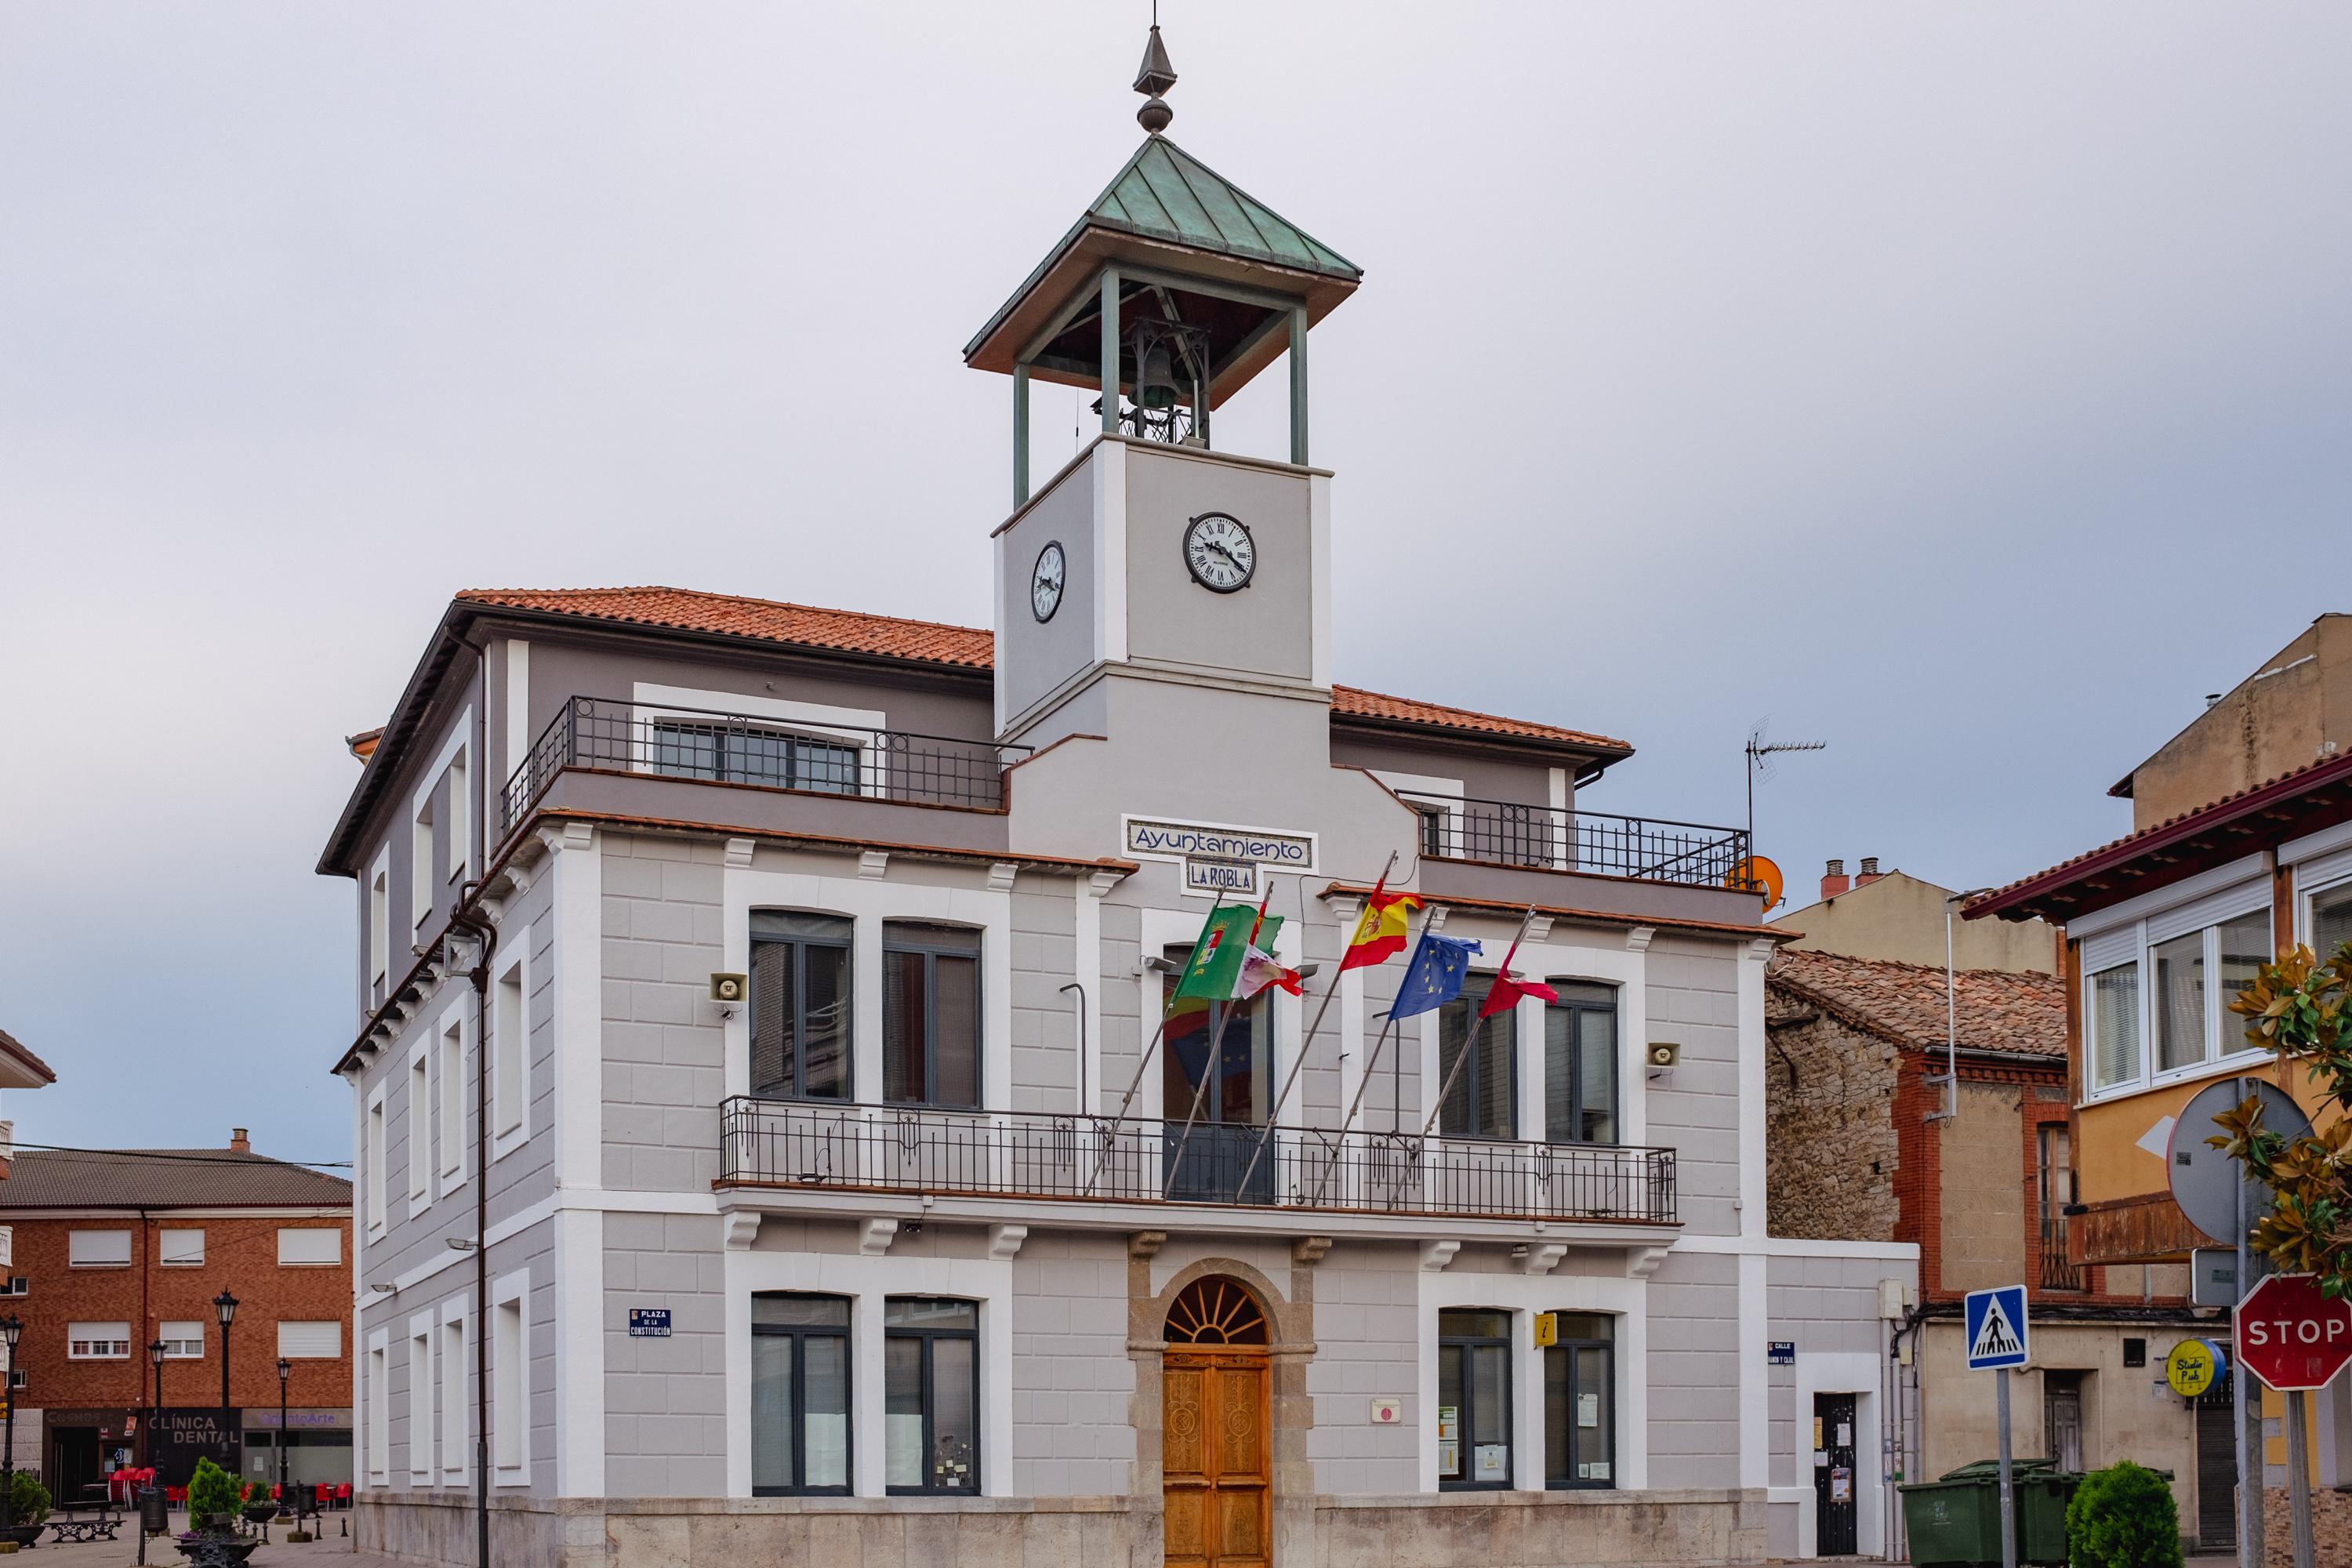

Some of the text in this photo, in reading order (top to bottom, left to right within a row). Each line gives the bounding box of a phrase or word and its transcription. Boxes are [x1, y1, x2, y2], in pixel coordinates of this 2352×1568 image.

[1135, 827, 1303, 860] Ayuntamiento
[1191, 866, 1250, 888] LA ROBLA
[630, 1326, 670, 1335] CONSTITUCIÓN
[2249, 1319, 2345, 1345] STOP
[2181, 1370, 2199, 1381] Pub
[148, 1413, 216, 1429] CLÍNICA
